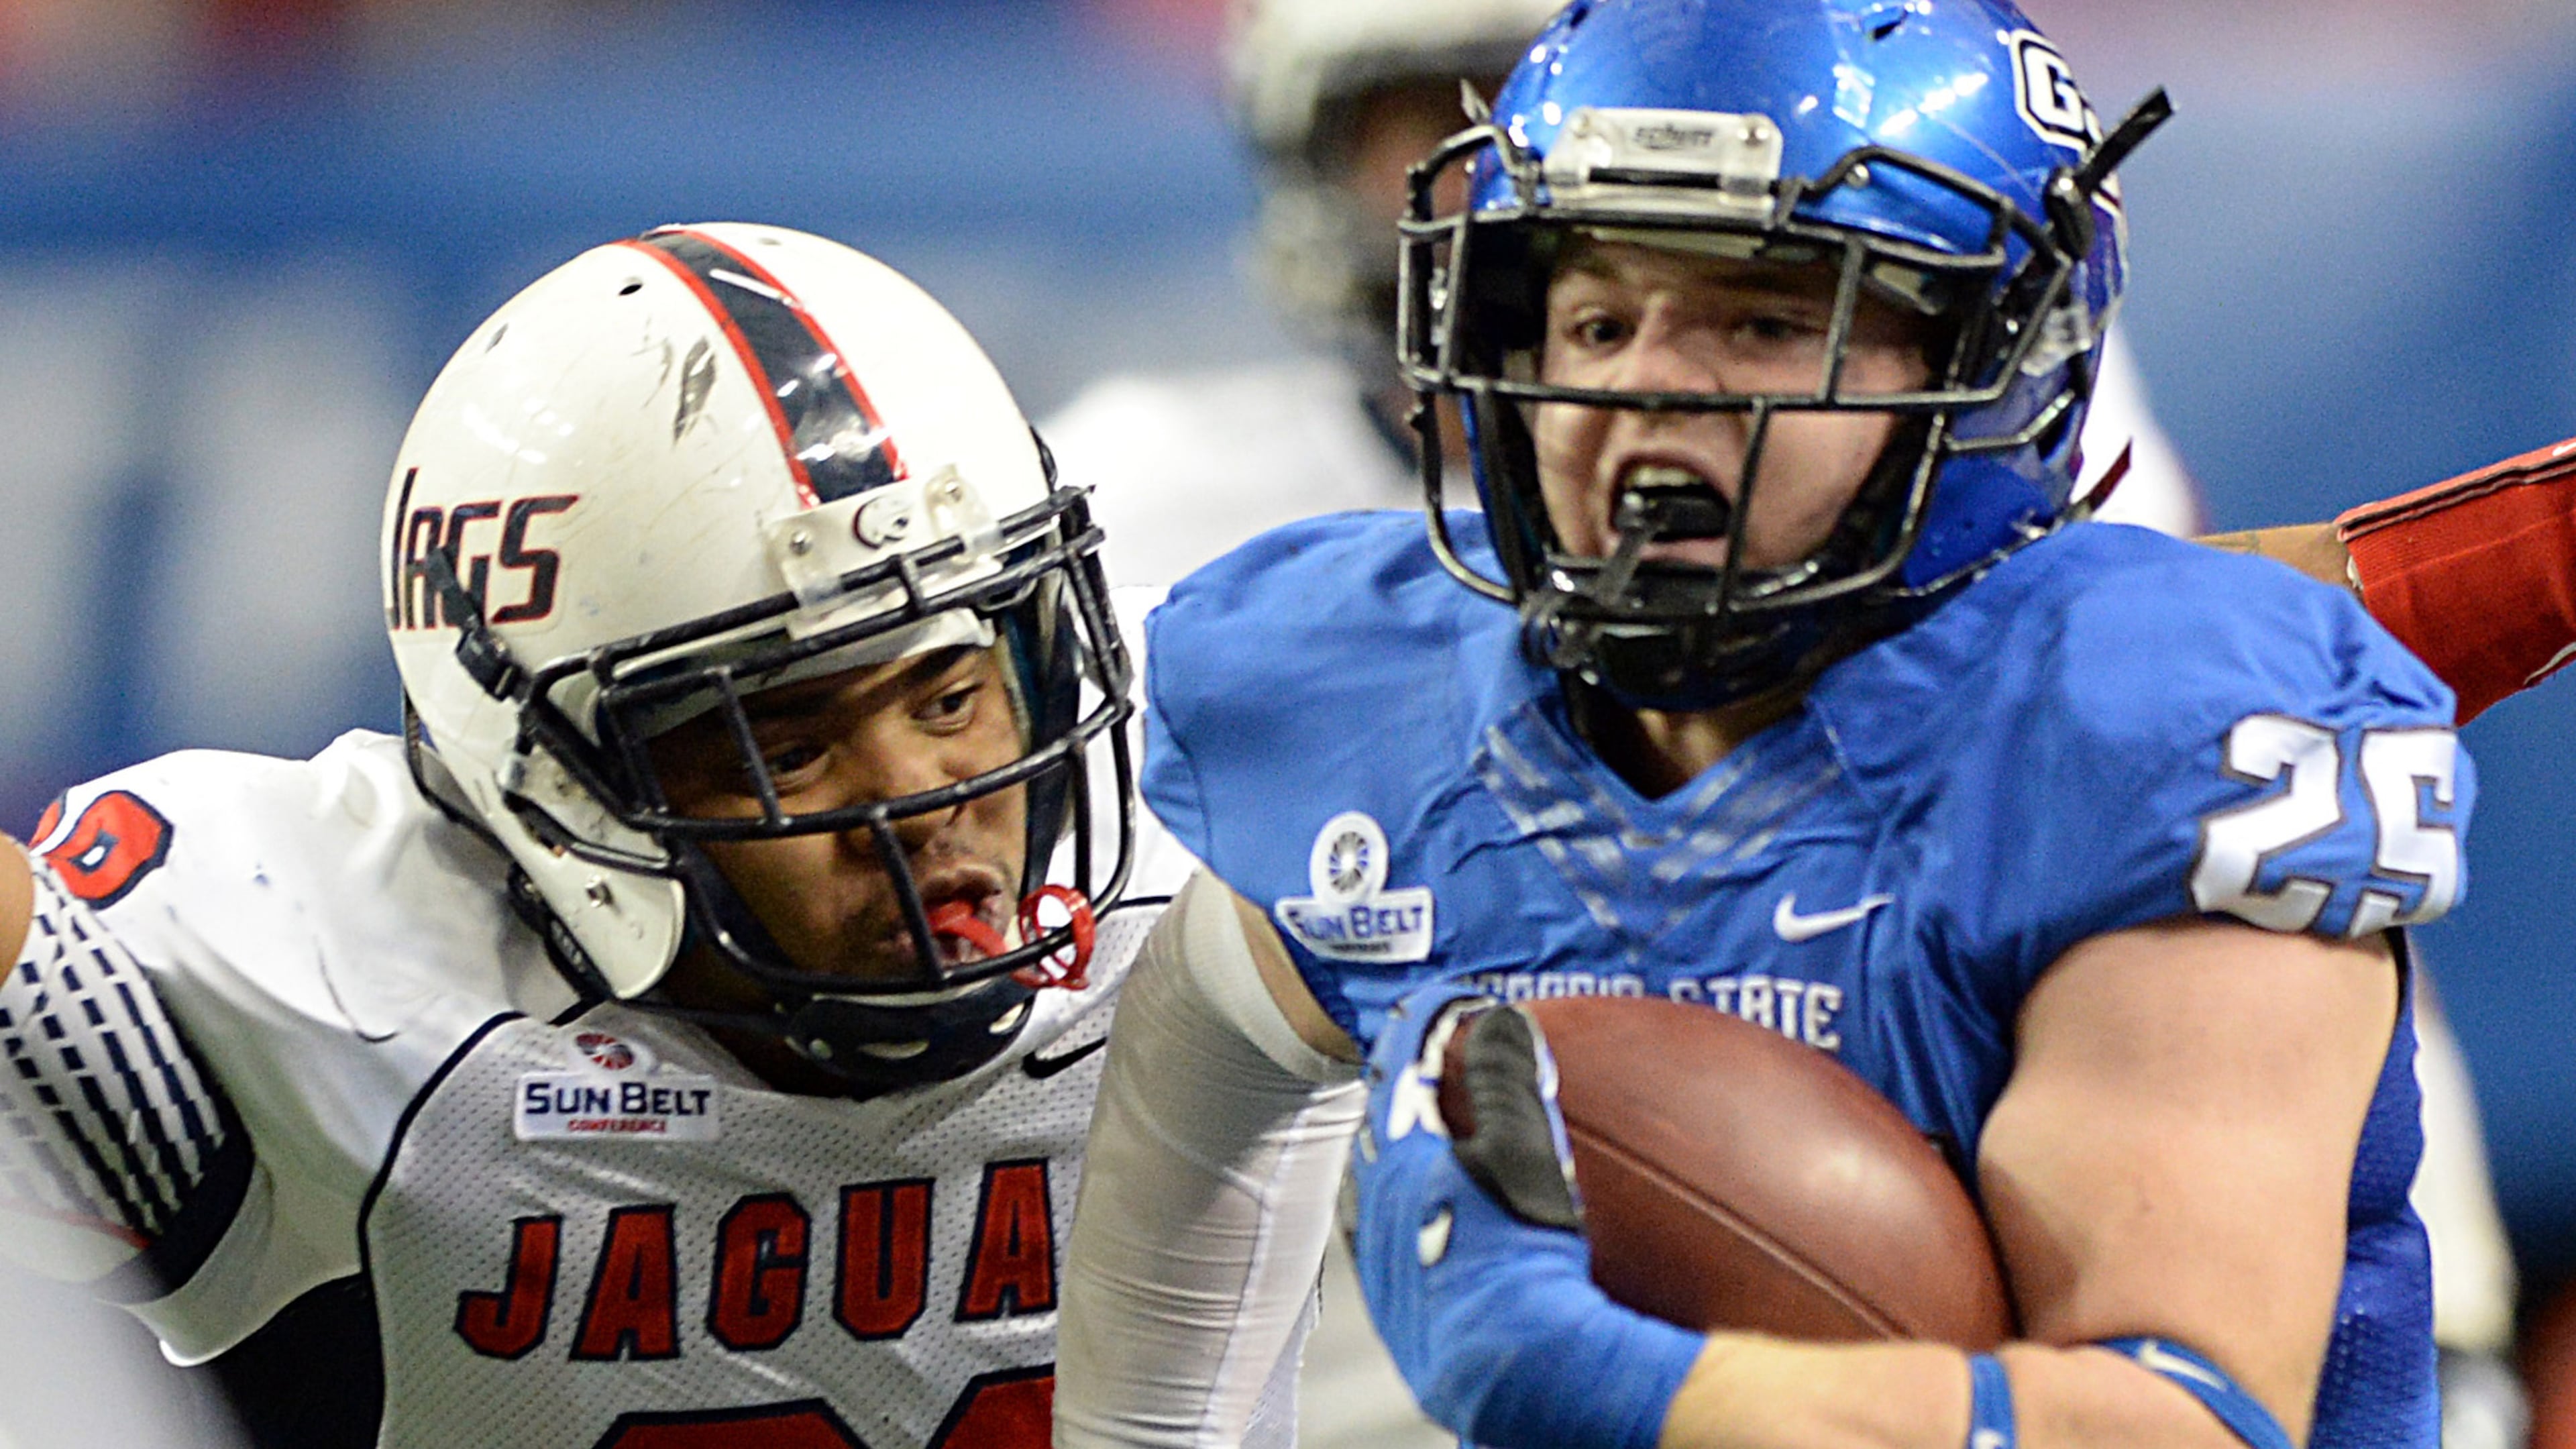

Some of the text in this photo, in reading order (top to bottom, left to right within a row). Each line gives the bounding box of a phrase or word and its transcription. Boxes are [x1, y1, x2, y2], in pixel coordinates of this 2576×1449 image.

[2188, 712, 2458, 939] 25
[1350, 906, 1422, 939] BELT
[525, 1081, 710, 1116] SUN BELT
